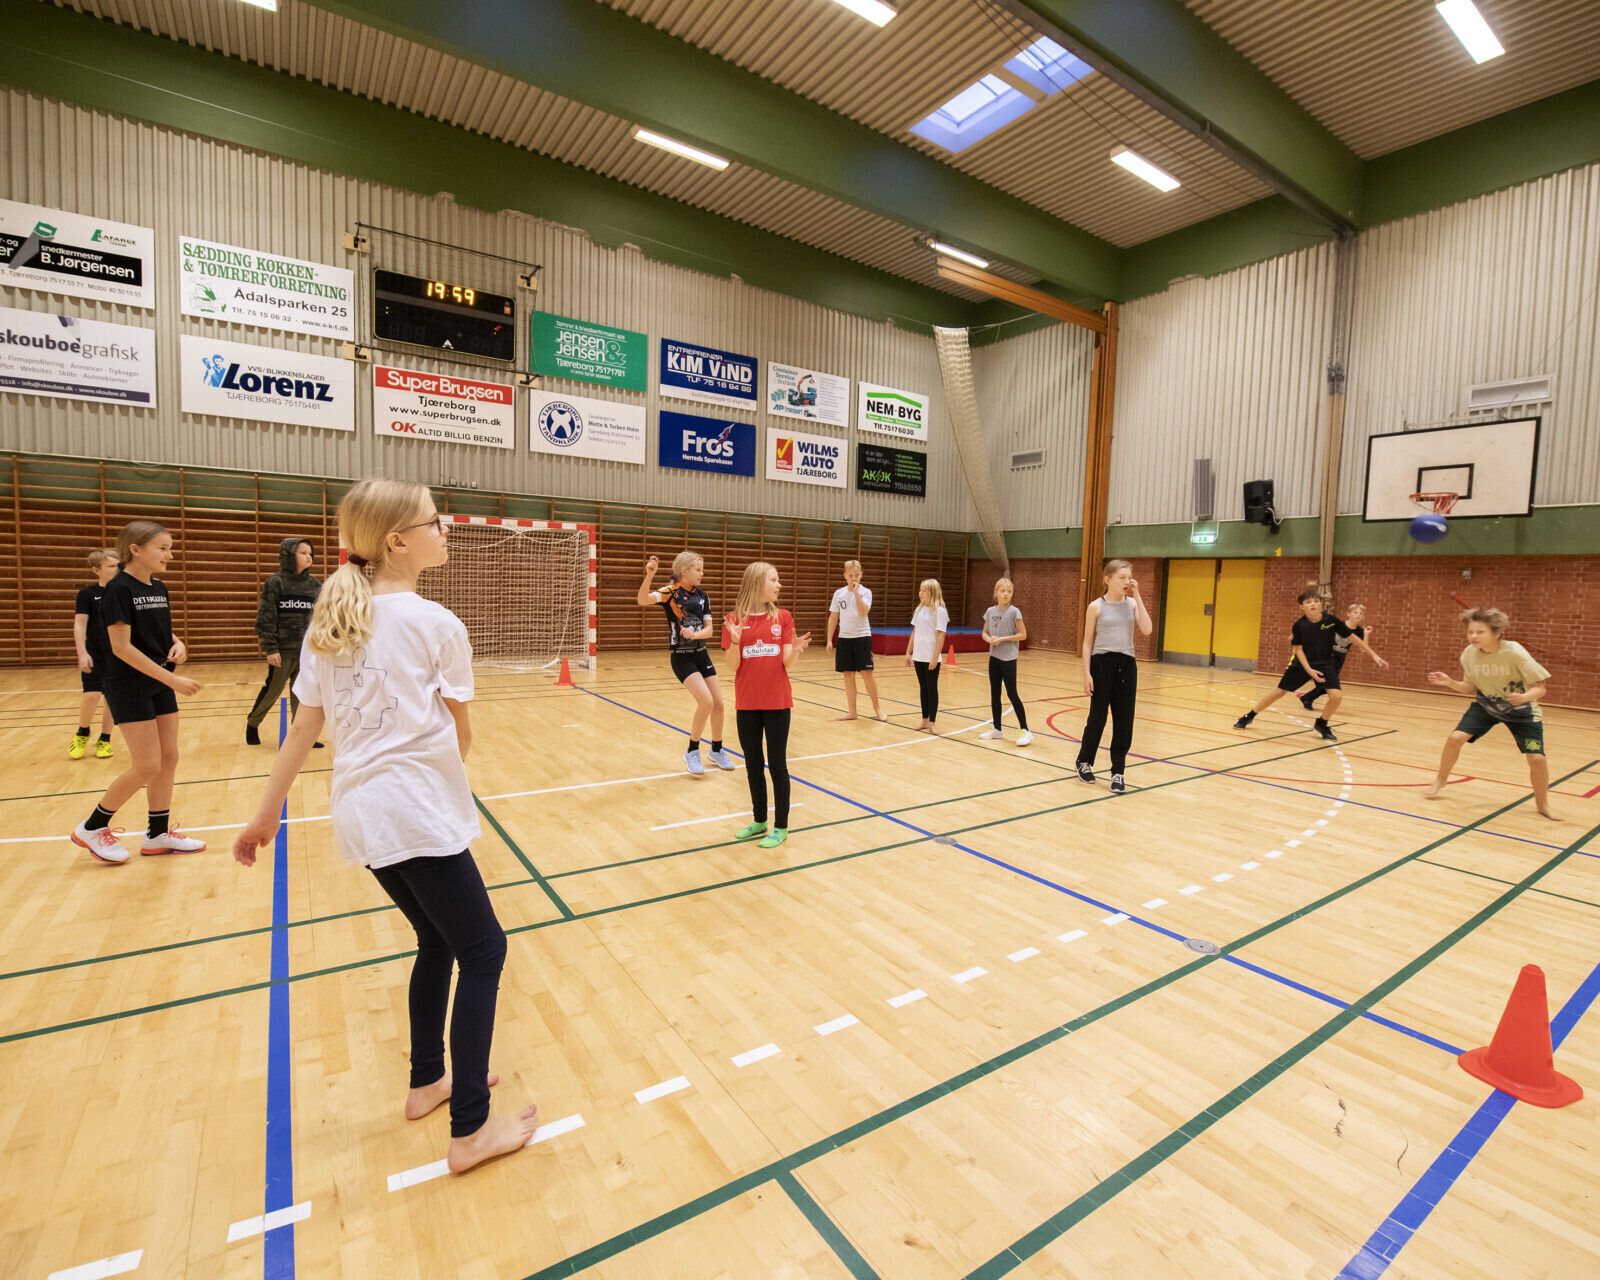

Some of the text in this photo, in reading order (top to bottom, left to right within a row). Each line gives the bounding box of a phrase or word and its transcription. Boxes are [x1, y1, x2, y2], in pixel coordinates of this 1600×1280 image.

[41, 245, 103, 261] snedkermester
[183, 242, 251, 268] SÆDDING
[41, 252, 135, 279] B. Jørgensen
[184, 258, 347, 301] & TØMRERFORRETNING
[427, 282, 475, 306] 19:59
[331, 306, 347, 318] 25
[8, 355, 139, 377] Firmaprofilering Annoncer Tryksager
[556, 358, 595, 373] Tjæreborg
[20, 365, 52, 375] Websites
[59, 370, 77, 378] Skilte
[83, 373, 128, 384] Autoreklamer
[221, 363, 334, 402] Lorenz
[686, 375, 701, 383] TLF
[226, 392, 282, 406] TJÆREBORG
[418, 396, 476, 414] Tjæreborg
[391, 421, 503, 445] OK ALTID BILLIG BENZIN
[797, 441, 839, 458] WILMS
[801, 455, 834, 470] AUTO
[796, 467, 837, 480] TJÆREBORG
[280, 600, 312, 609] adidas
